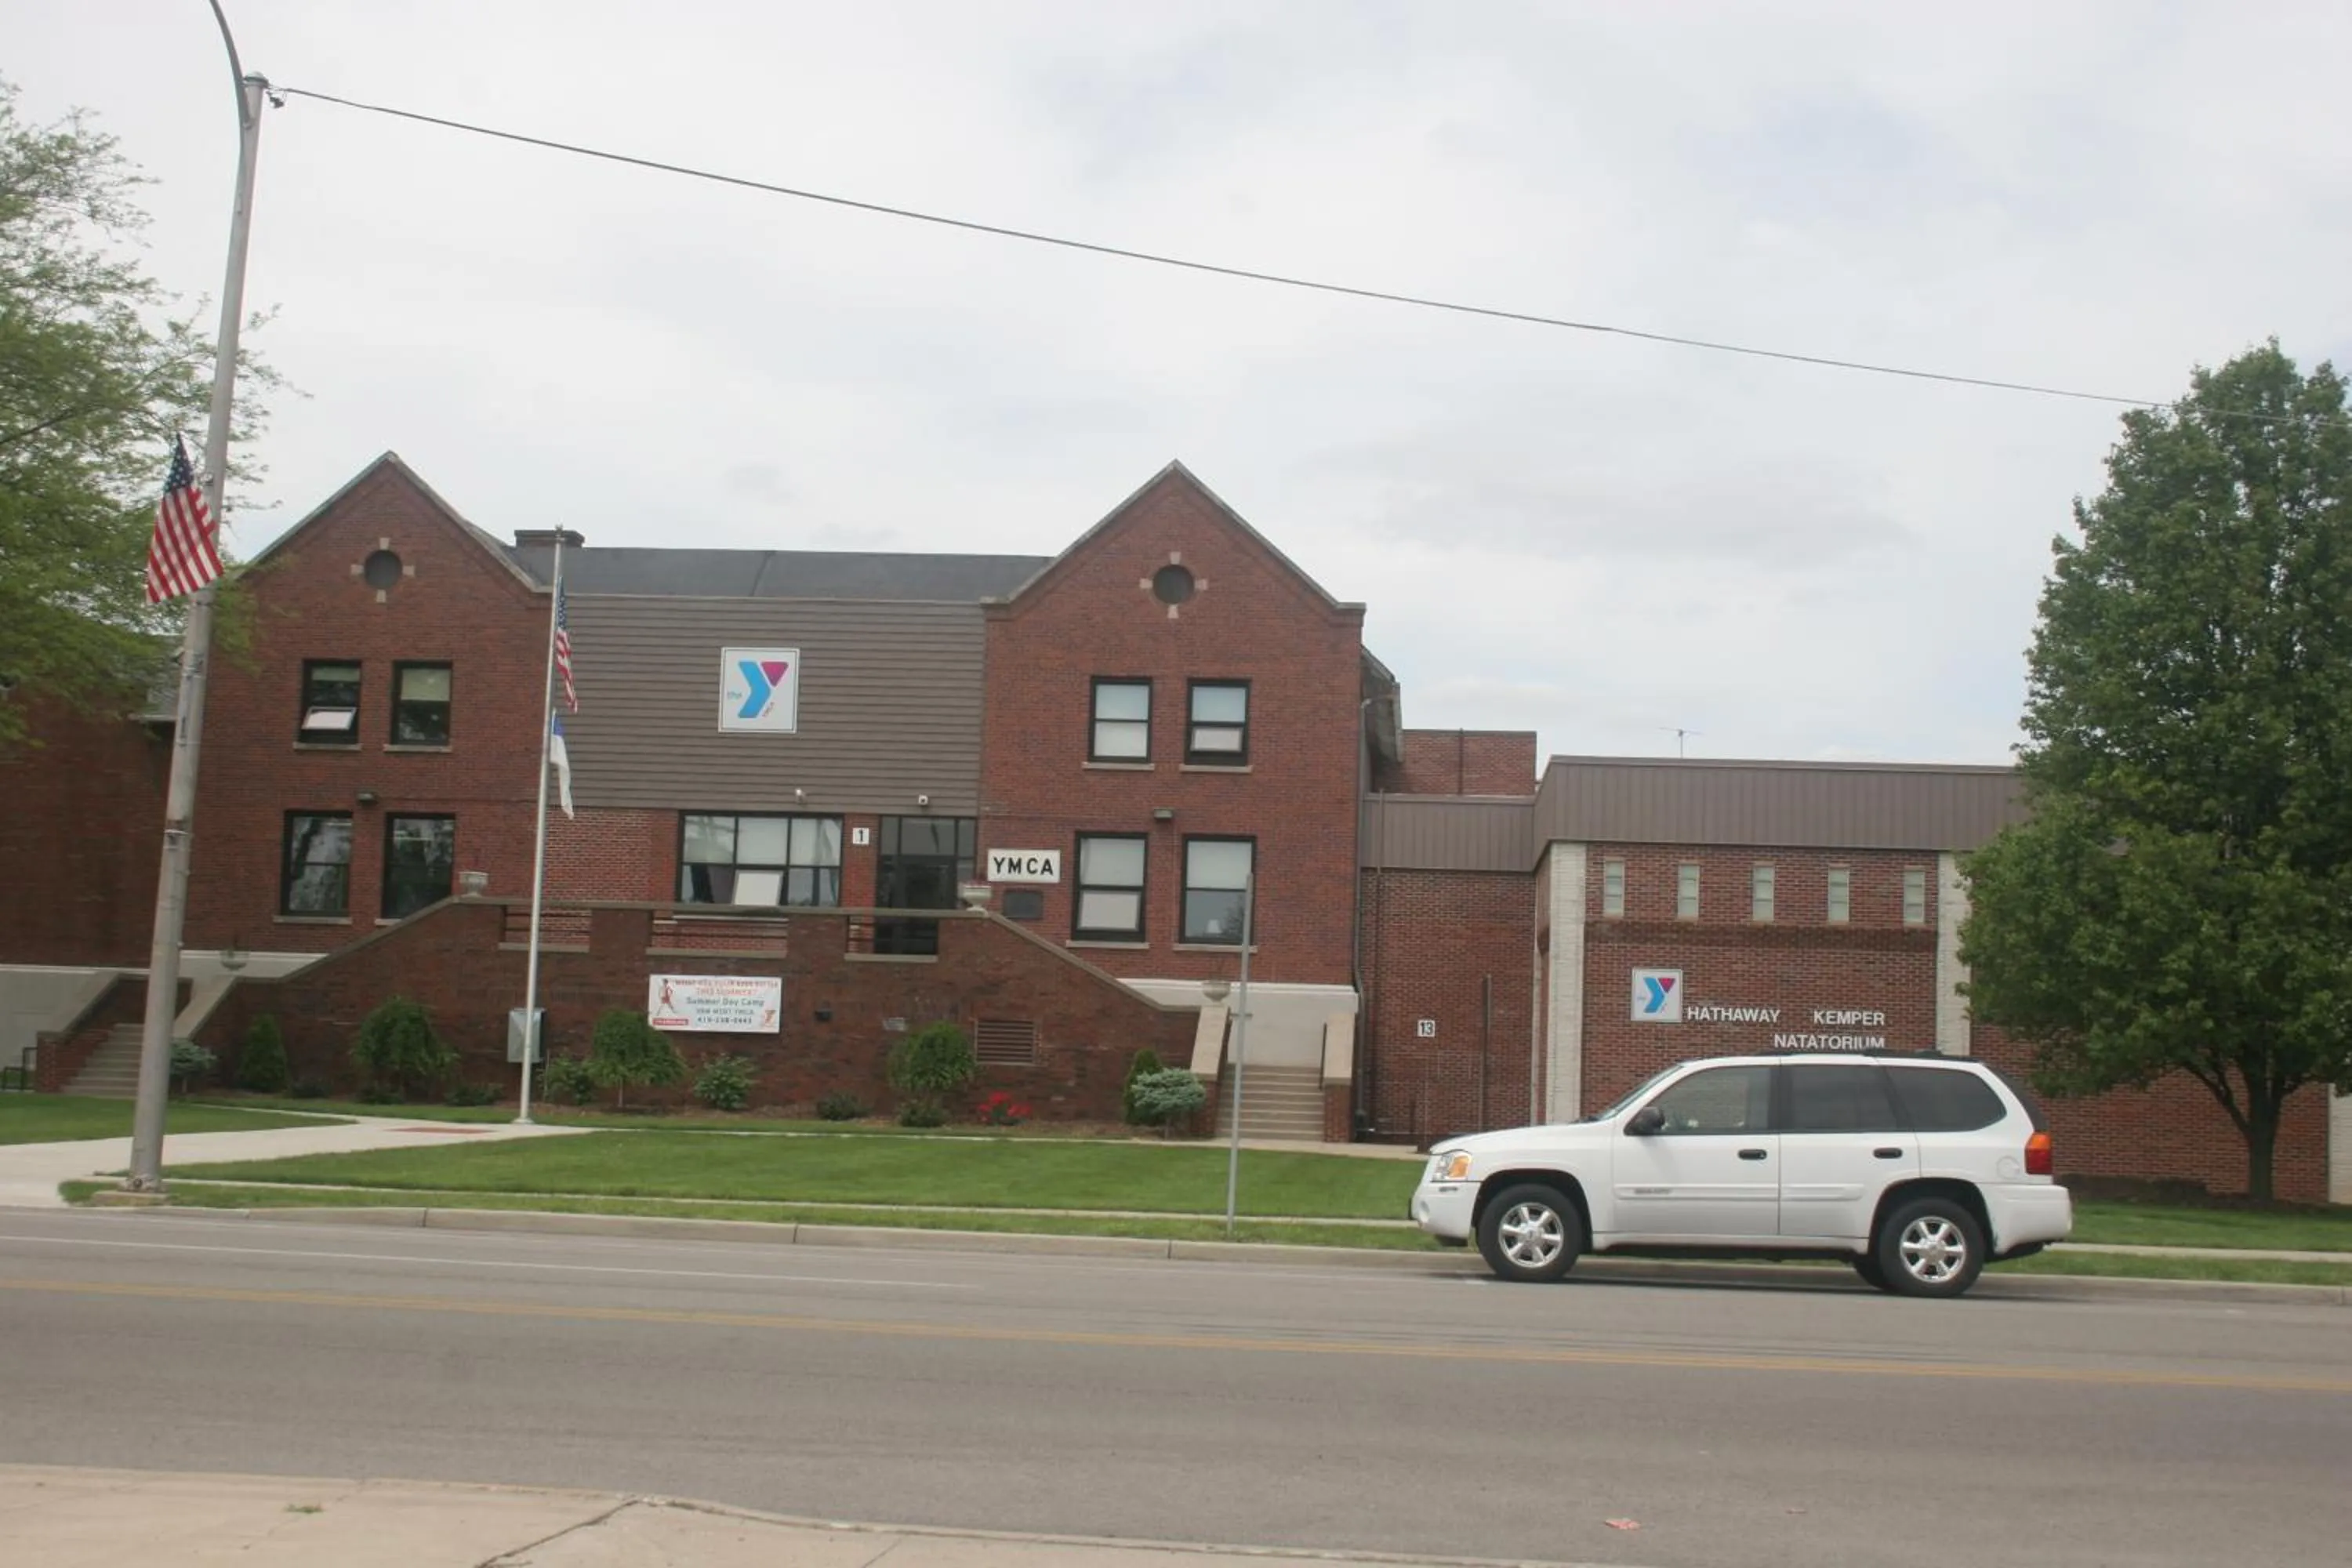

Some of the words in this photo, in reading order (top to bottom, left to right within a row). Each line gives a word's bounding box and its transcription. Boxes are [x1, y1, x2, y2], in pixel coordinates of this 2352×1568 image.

[858, 829, 864, 842] 1
[993, 857, 1054, 876] YMCA
[723, 997, 739, 1006] Day
[741, 998, 765, 1007] Camp
[1687, 1007, 1781, 1024] HATHAWAY
[1813, 1010, 1885, 1026] KEMPER
[1420, 1022, 1434, 1036] 13
[1774, 1033, 1885, 1050] NATATORIUM
